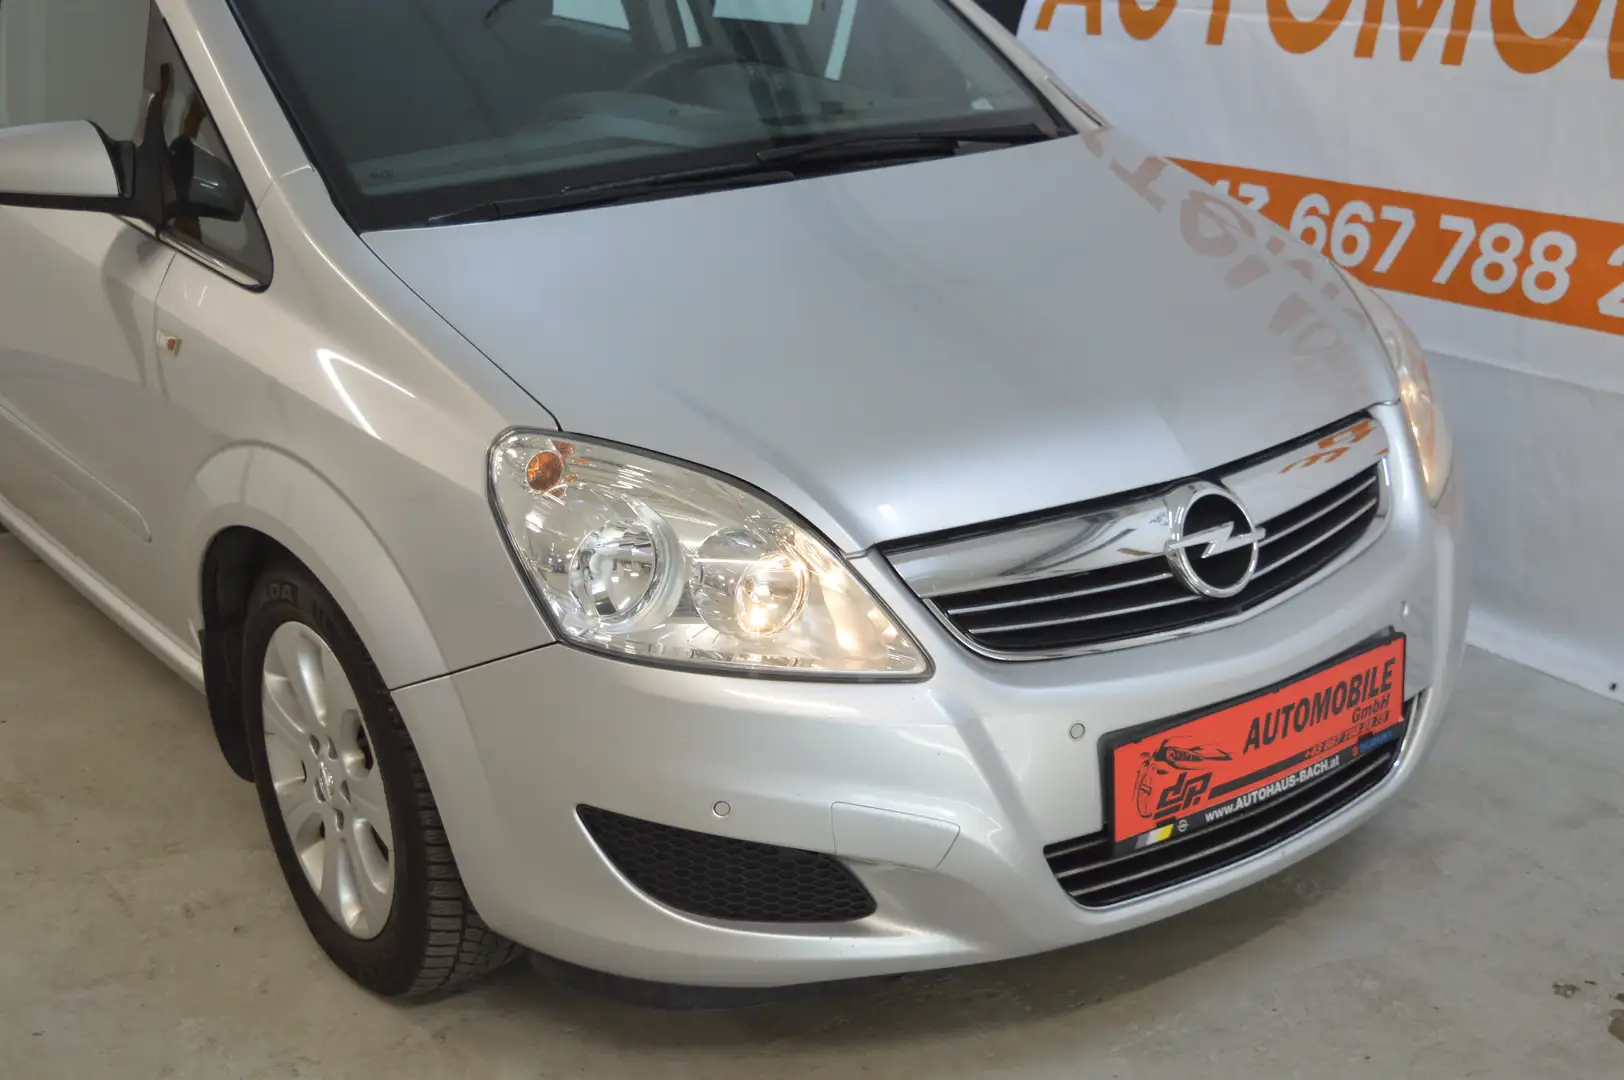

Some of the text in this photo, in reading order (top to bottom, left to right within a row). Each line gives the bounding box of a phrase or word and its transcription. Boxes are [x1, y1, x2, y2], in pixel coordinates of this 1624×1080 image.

[1289, 193, 1416, 273] 667
[1432, 216, 1577, 304] 788
[1243, 657, 1396, 755] AUTOMOBILE
[1352, 694, 1391, 724] GmbH
[1204, 755, 1341, 823] www.AUTOHAUS-BACH.at
